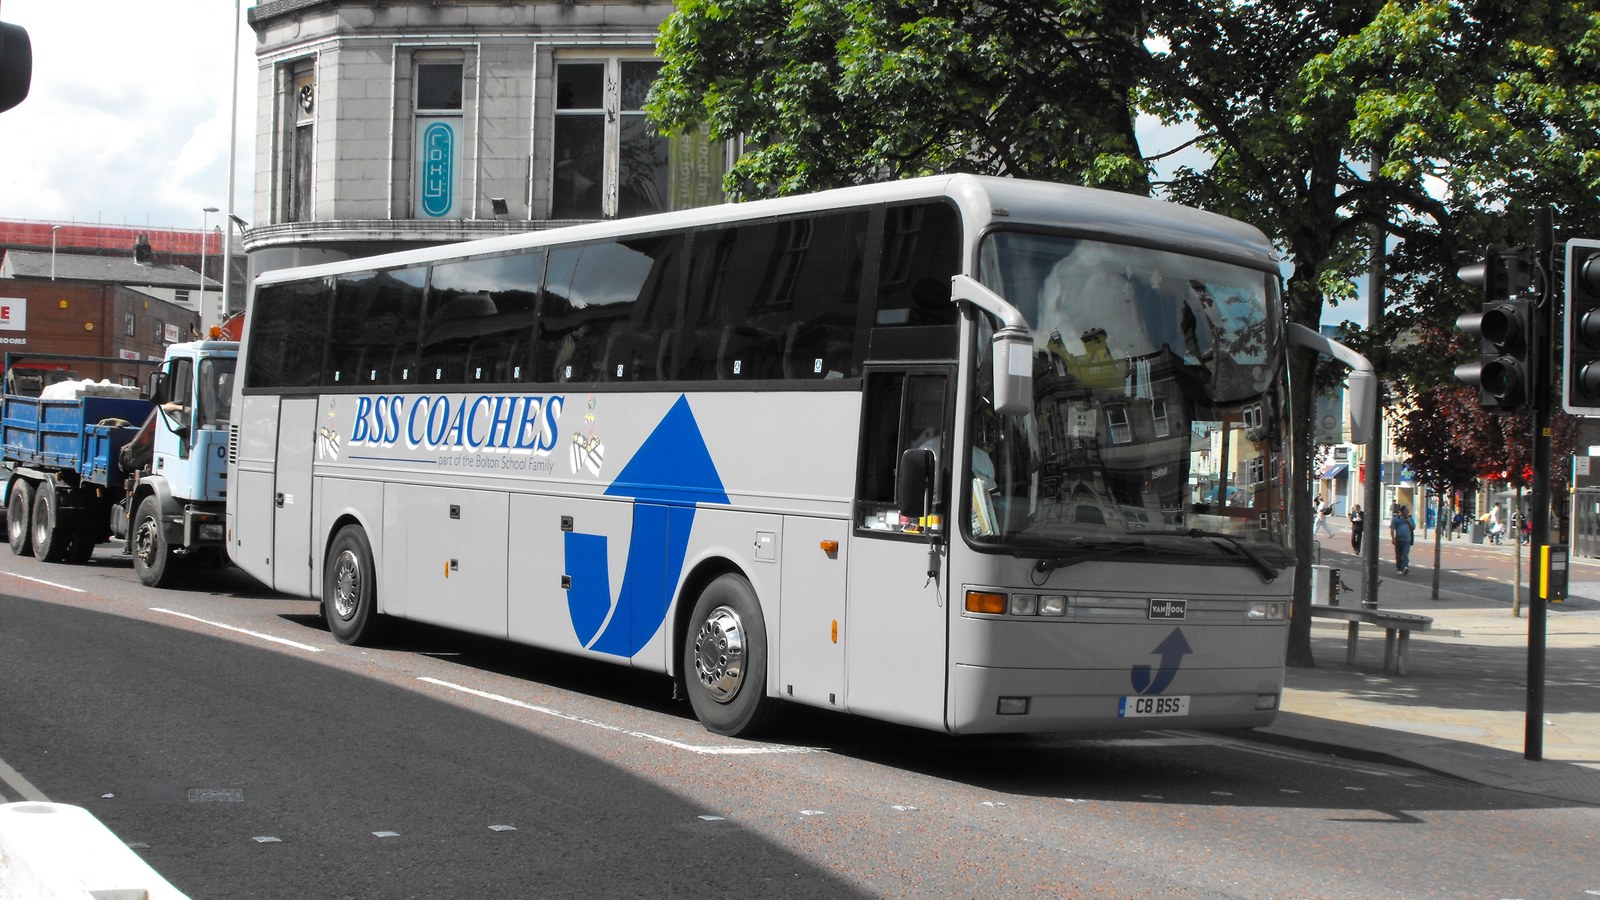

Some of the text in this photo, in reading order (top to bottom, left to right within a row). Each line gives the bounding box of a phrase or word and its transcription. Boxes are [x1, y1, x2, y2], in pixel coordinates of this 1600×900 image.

[349, 395, 566, 455] BSS COACHES
[438, 454, 554, 475] part of the Bolton School Family
[1135, 697, 1180, 714] C8 BSS
